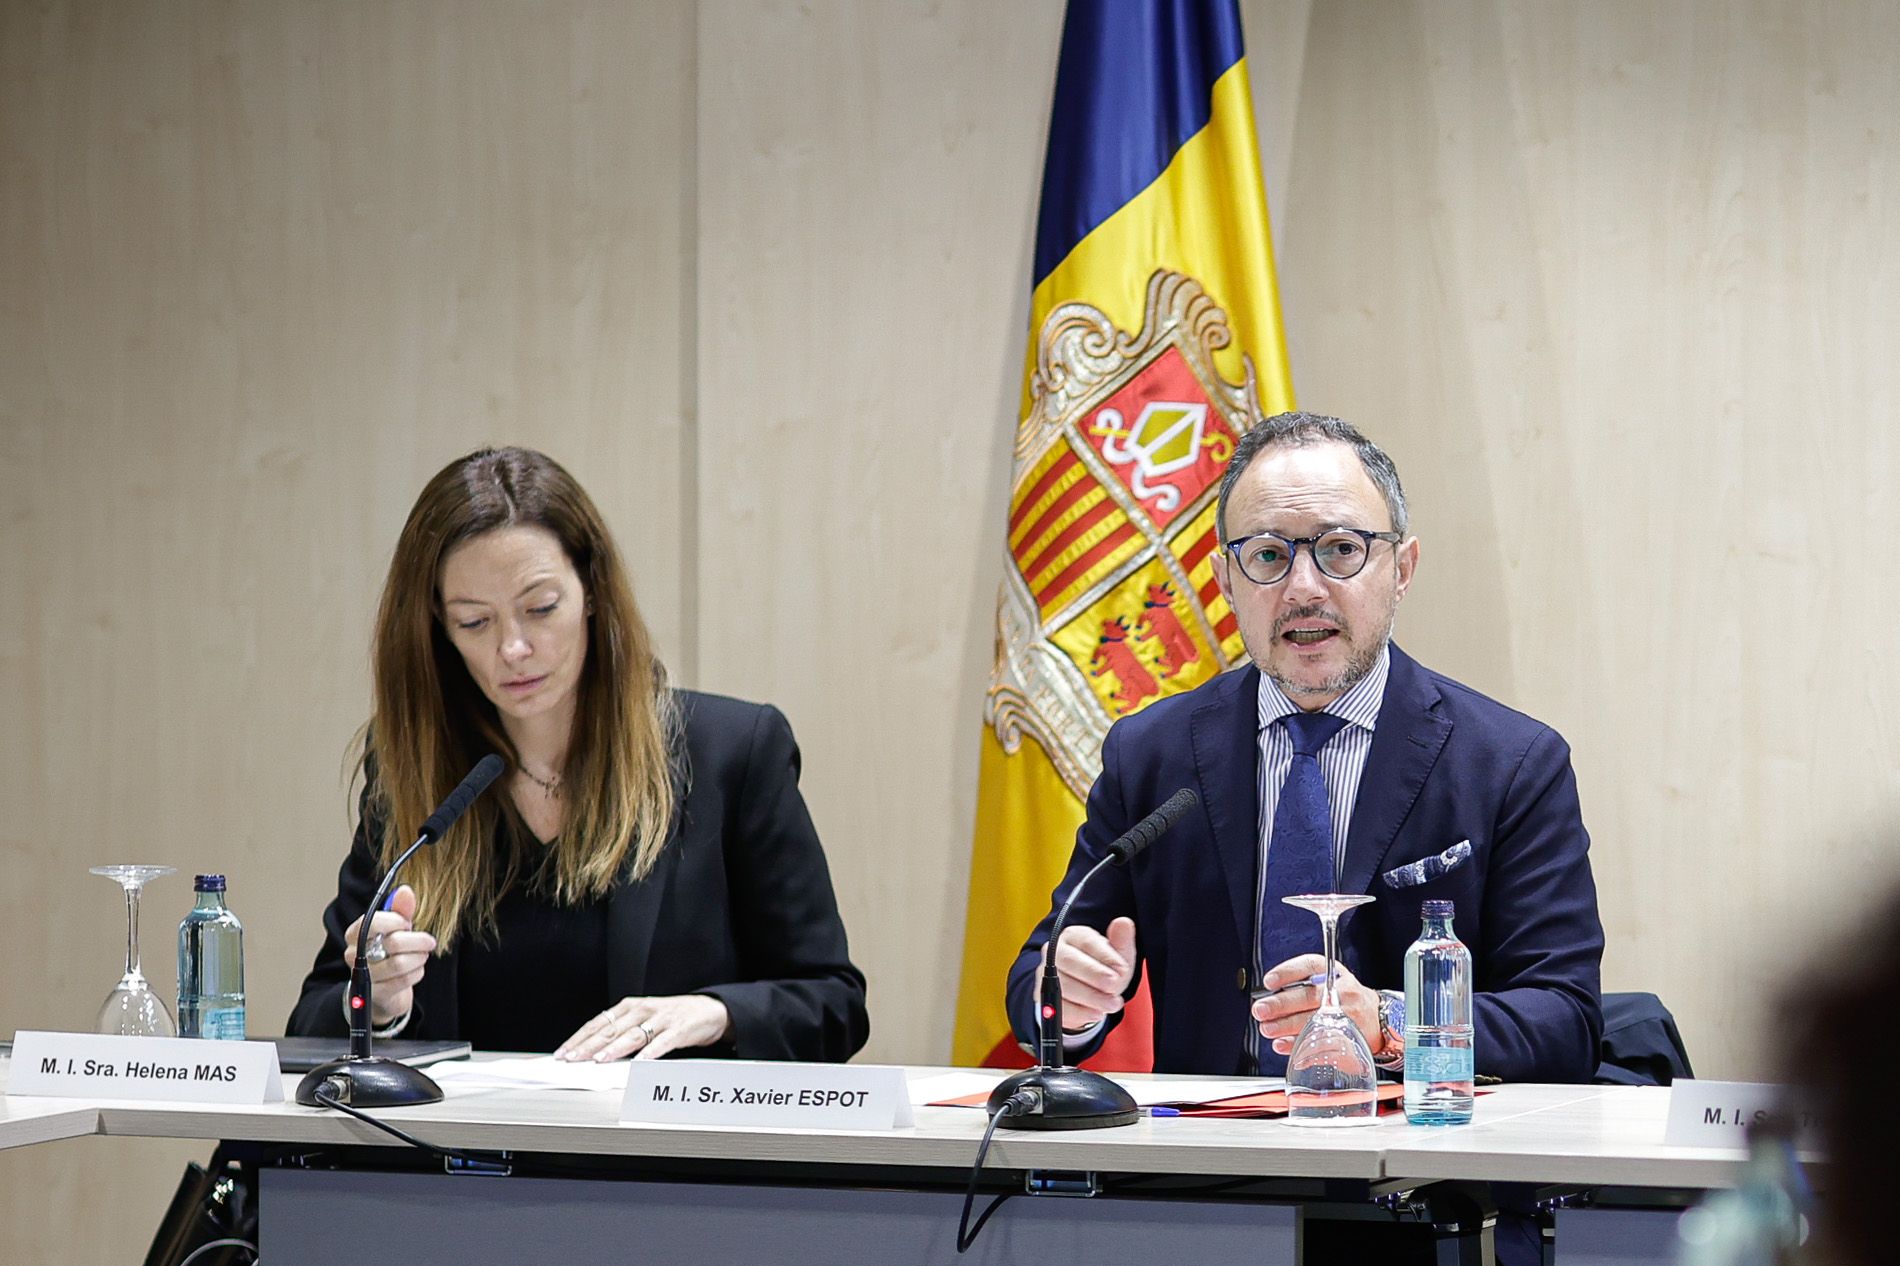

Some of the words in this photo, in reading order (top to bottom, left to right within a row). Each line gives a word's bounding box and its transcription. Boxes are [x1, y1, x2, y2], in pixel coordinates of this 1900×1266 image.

[40, 1057, 61, 1075] M.
[67, 1058, 77, 1075] I.
[83, 1059, 119, 1078] Sra.
[125, 1061, 188, 1081] Helena
[193, 1064, 238, 1082] MAS
[652, 1085, 674, 1102] M.
[680, 1086, 691, 1103] I.
[698, 1086, 724, 1104] Sr.
[730, 1087, 794, 1106] Xavier
[798, 1089, 869, 1107] ESPOT
[1703, 1106, 1727, 1125] M.
[1733, 1108, 1745, 1126] I.
